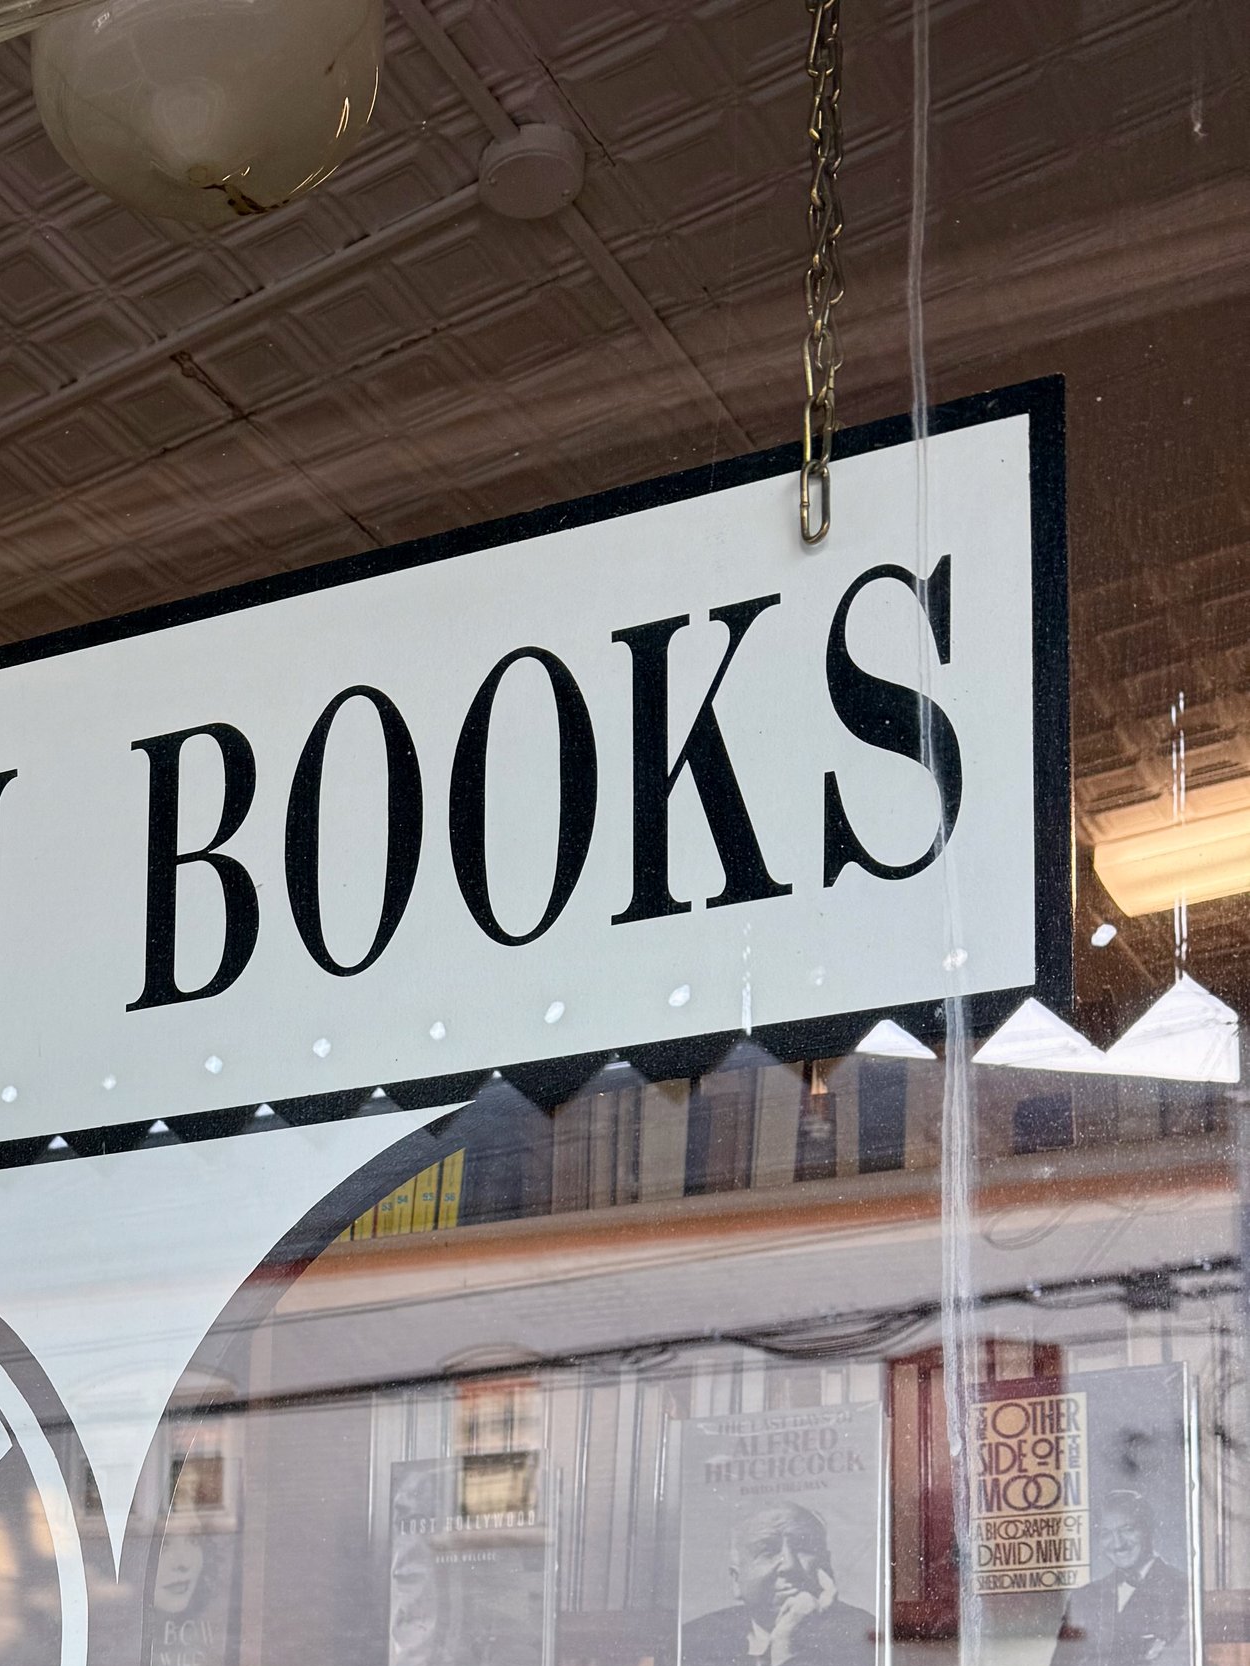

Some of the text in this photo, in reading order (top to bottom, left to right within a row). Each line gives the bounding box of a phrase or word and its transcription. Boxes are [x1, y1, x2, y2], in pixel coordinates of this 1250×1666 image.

[126, 554, 963, 1012] BOOKS
[992, 1398, 1080, 1439] OTHER
[733, 1428, 839, 1456] ALFRED
[978, 1439, 1027, 1476] SIDE
[1032, 1436, 1065, 1470] OF
[704, 1450, 866, 1484] HITCHCOCK
[978, 1472, 1081, 1513] MOON
[401, 1510, 536, 1535] LOST HOLLYWOOD
[976, 1515, 1082, 1541] A BIOGRAPHY OF
[978, 1539, 1081, 1567] DAVID NIVEN
[1029, 1570, 1078, 1588] MORLEY
